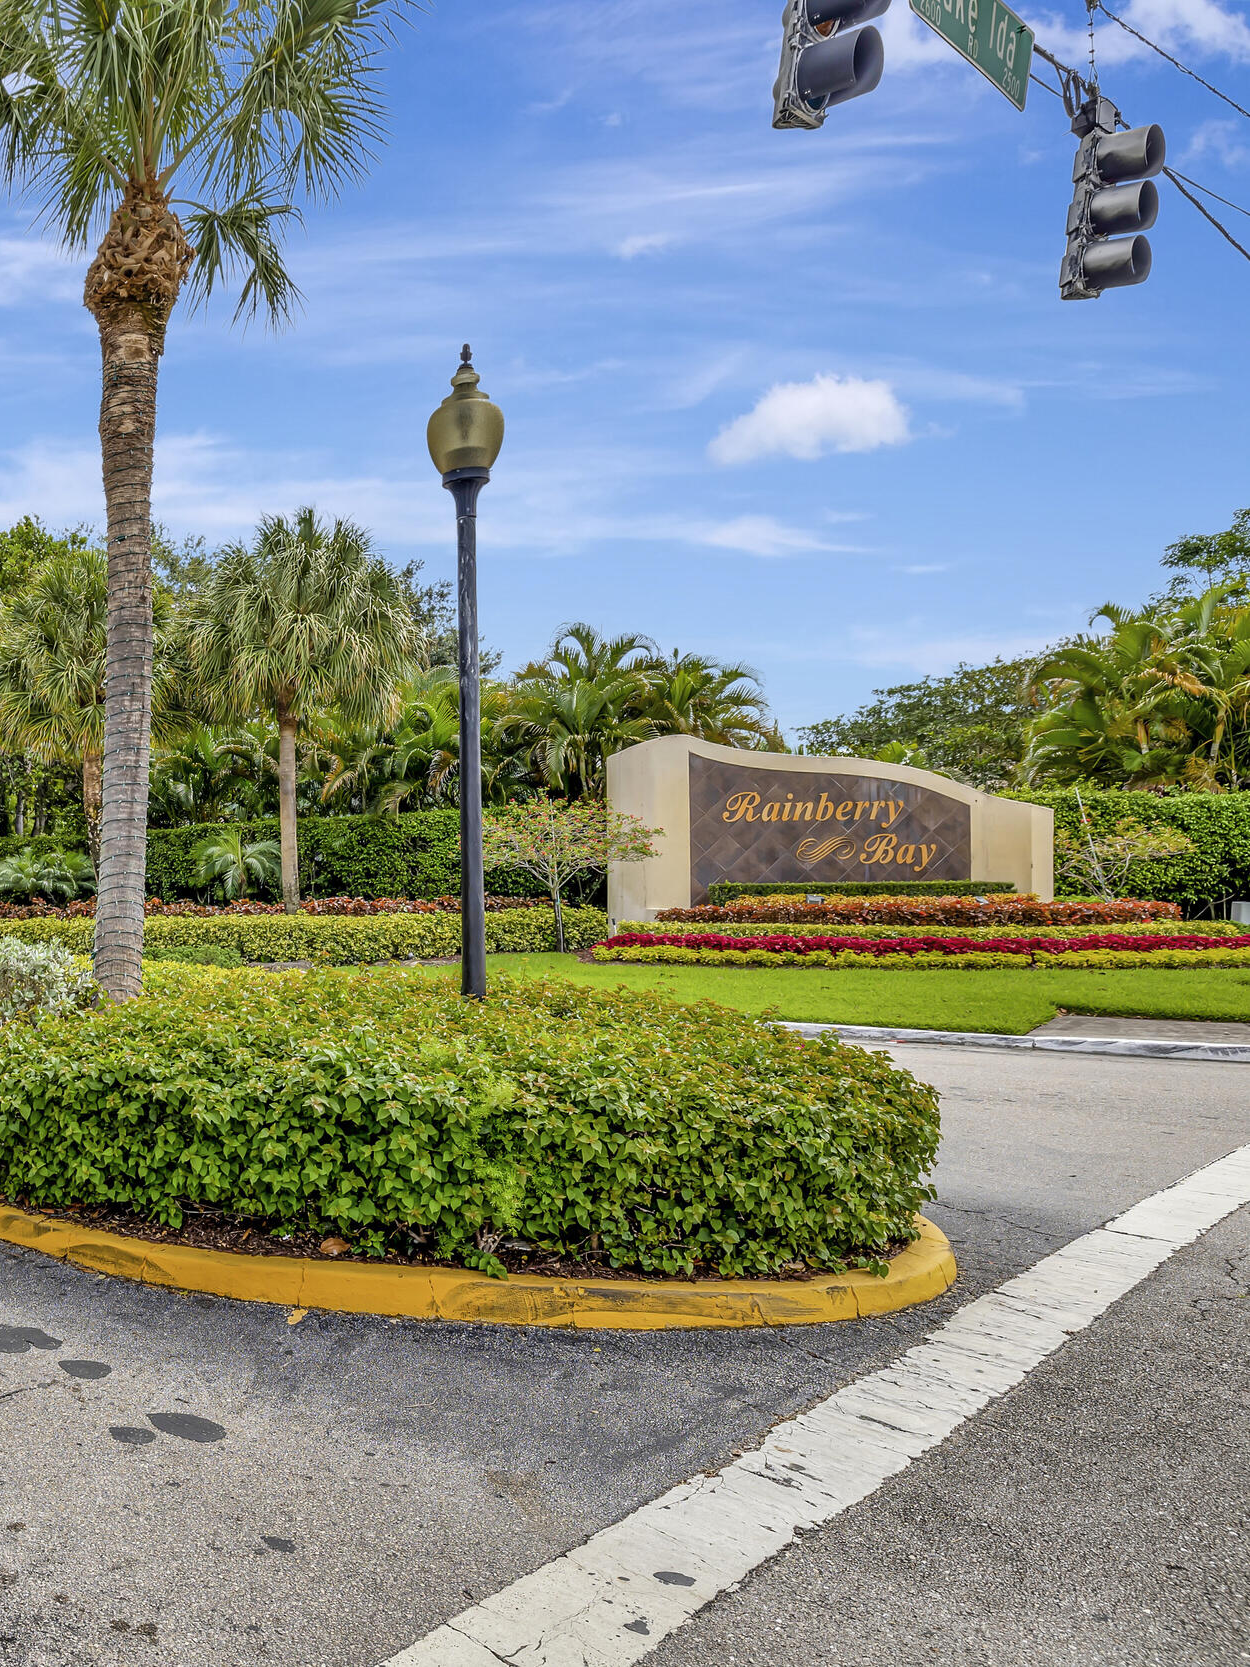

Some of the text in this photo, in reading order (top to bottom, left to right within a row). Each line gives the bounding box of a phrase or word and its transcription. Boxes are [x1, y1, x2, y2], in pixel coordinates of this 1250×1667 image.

[936, 0, 1017, 70] ke Ida
[967, 34, 979, 60] RD
[1002, 67, 1020, 99] 2500
[722, 791, 905, 829] Rainberry
[859, 833, 937, 872] Bay
